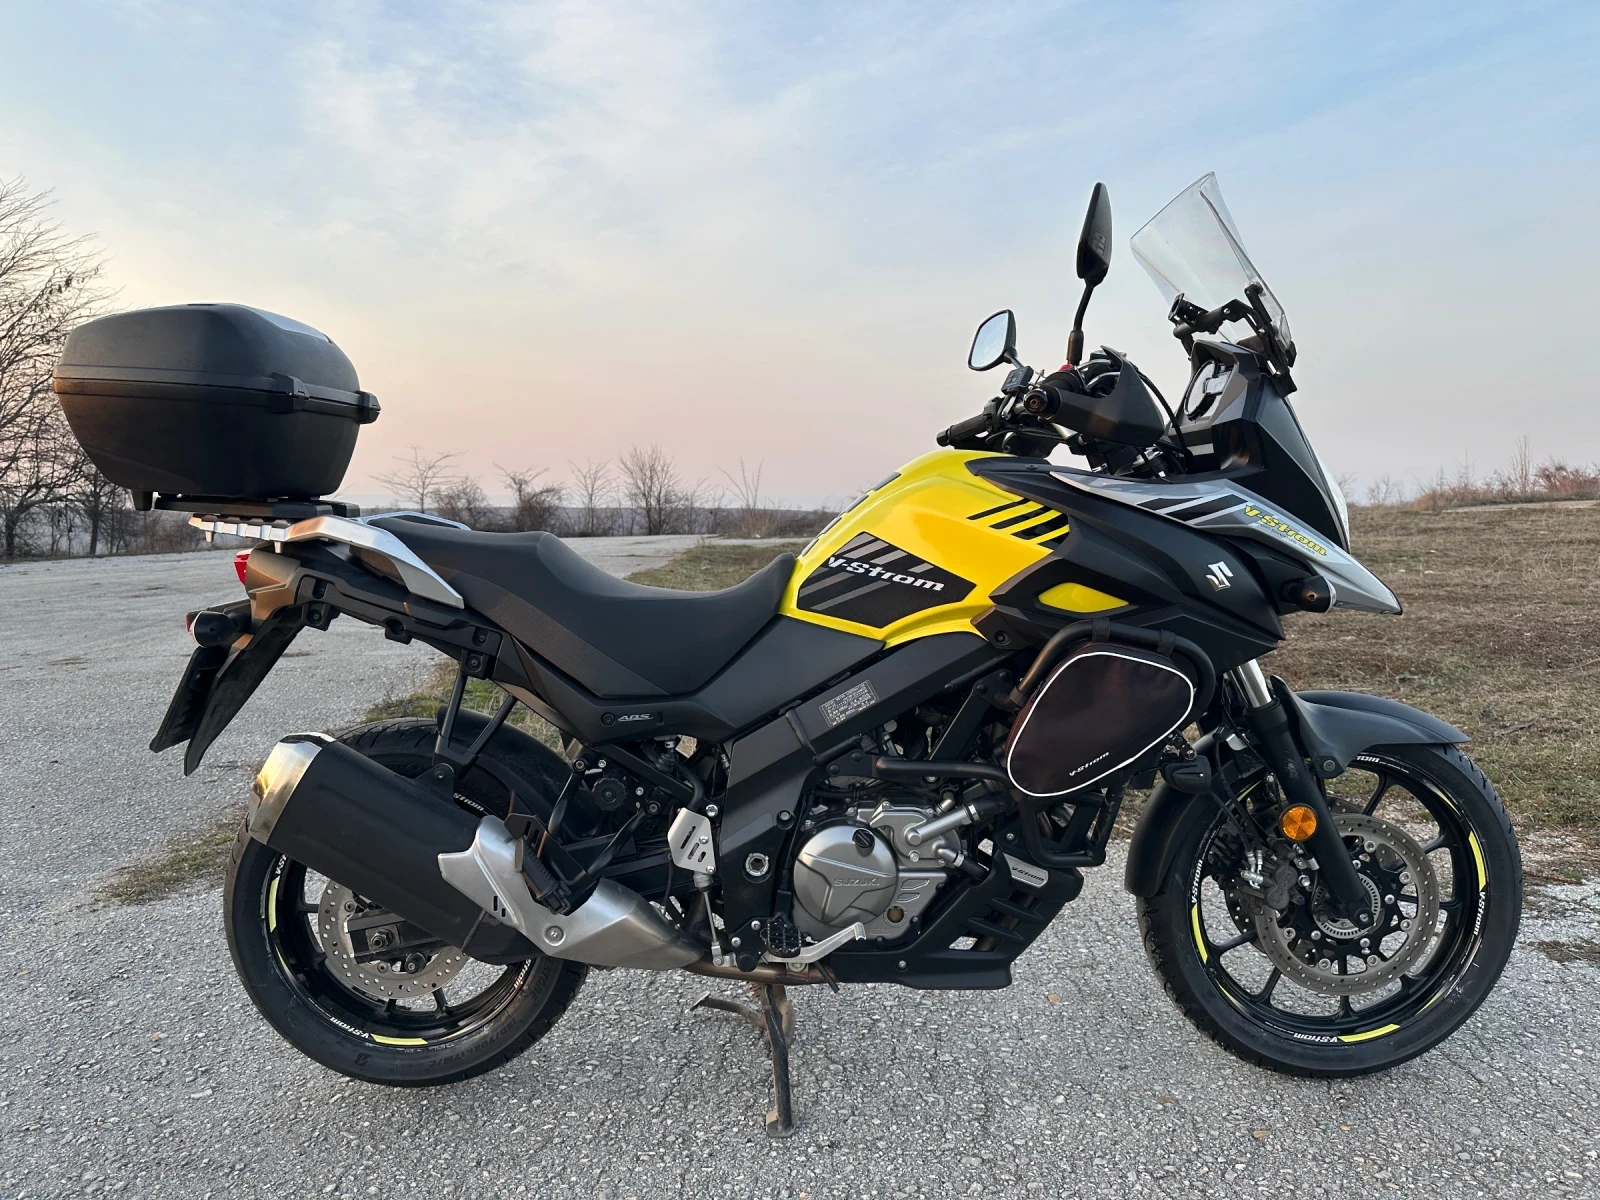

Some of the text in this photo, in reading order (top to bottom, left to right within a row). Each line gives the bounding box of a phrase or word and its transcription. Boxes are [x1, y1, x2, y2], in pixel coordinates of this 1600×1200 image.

[1244, 504, 1327, 556] V-Strom
[828, 556, 944, 591] V-Strom
[617, 713, 651, 721] ABS
[1069, 751, 1109, 776] V-Strom
[1012, 866, 1044, 881] V-Strom
[833, 877, 880, 887] SUZUKI
[1293, 1032, 1338, 1043] V-Strom
